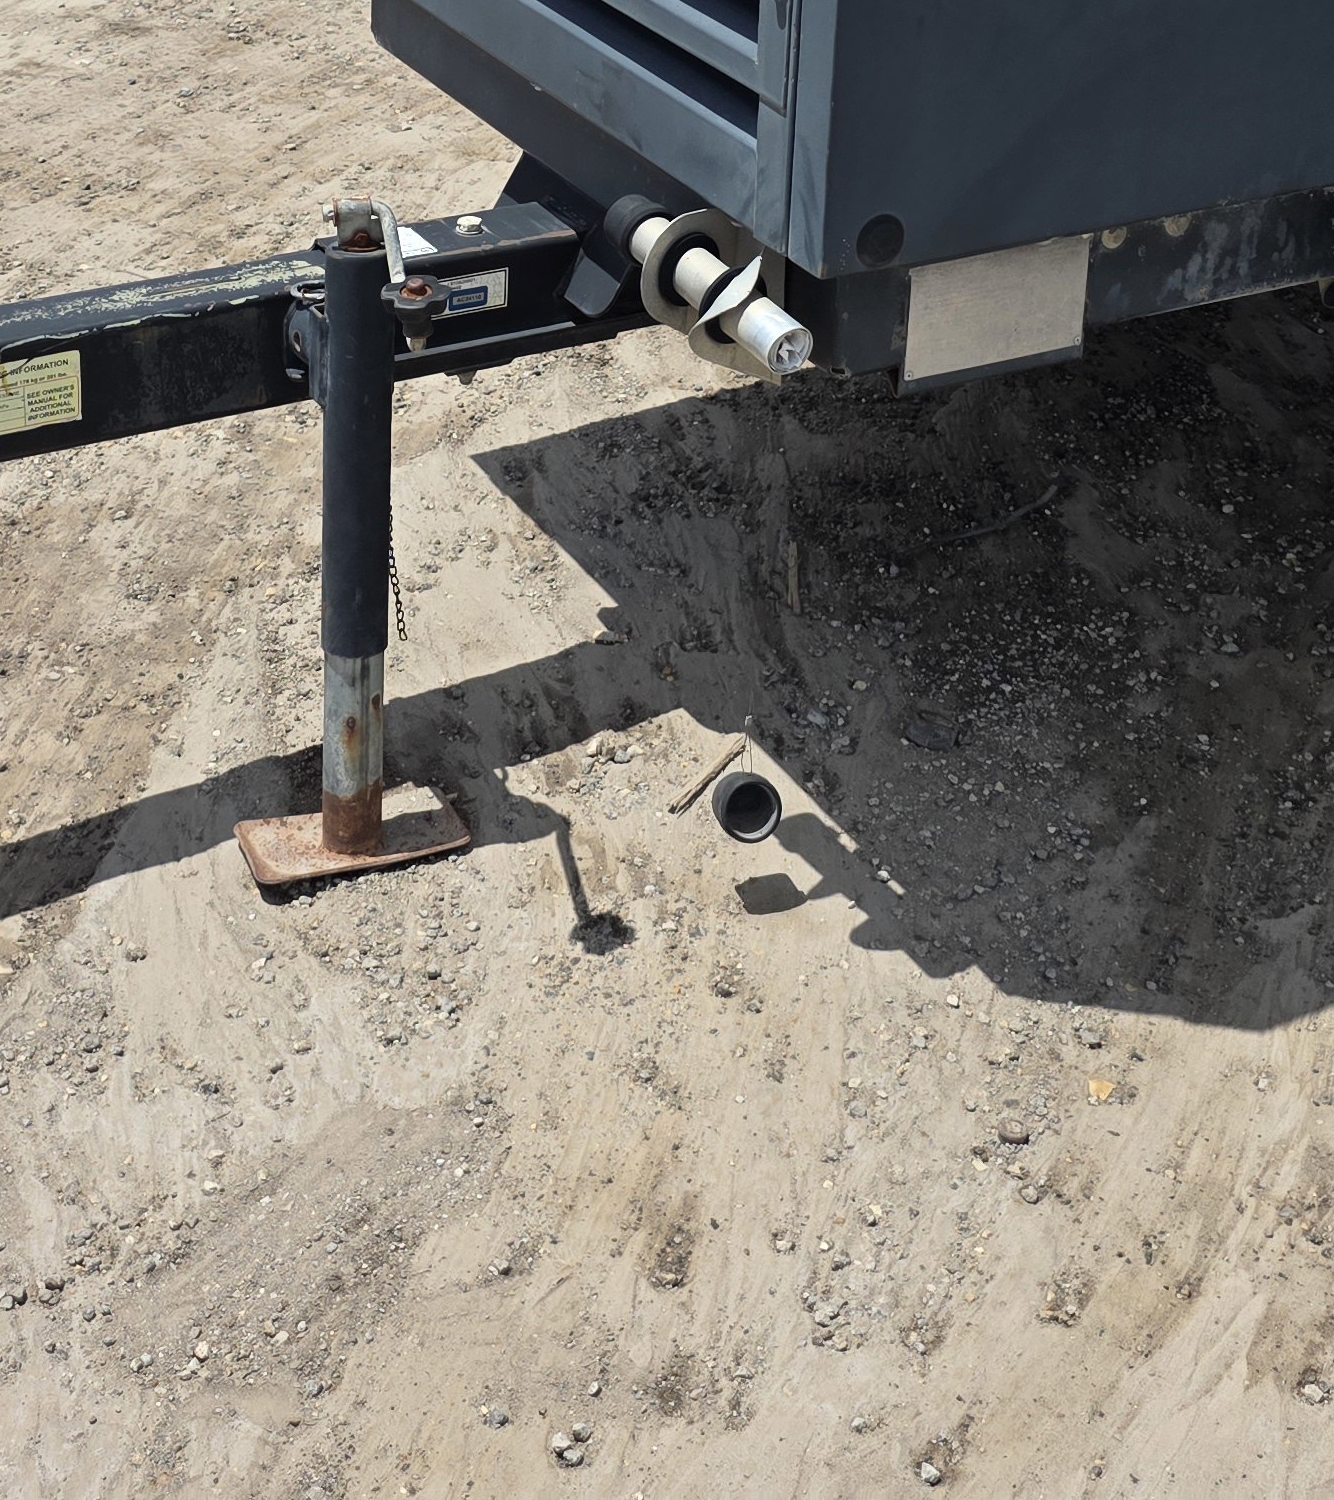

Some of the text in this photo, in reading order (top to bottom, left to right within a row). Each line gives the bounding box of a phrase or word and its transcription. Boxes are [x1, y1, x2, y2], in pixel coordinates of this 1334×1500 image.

[9, 358, 70, 376] INFORMATION
[26, 384, 75, 399] SEE OWNER'S
[27, 392, 73, 407] MANUAL FOR
[27, 407, 76, 421] INFORMATION
[30, 401, 72, 414] ADDITIONAL
